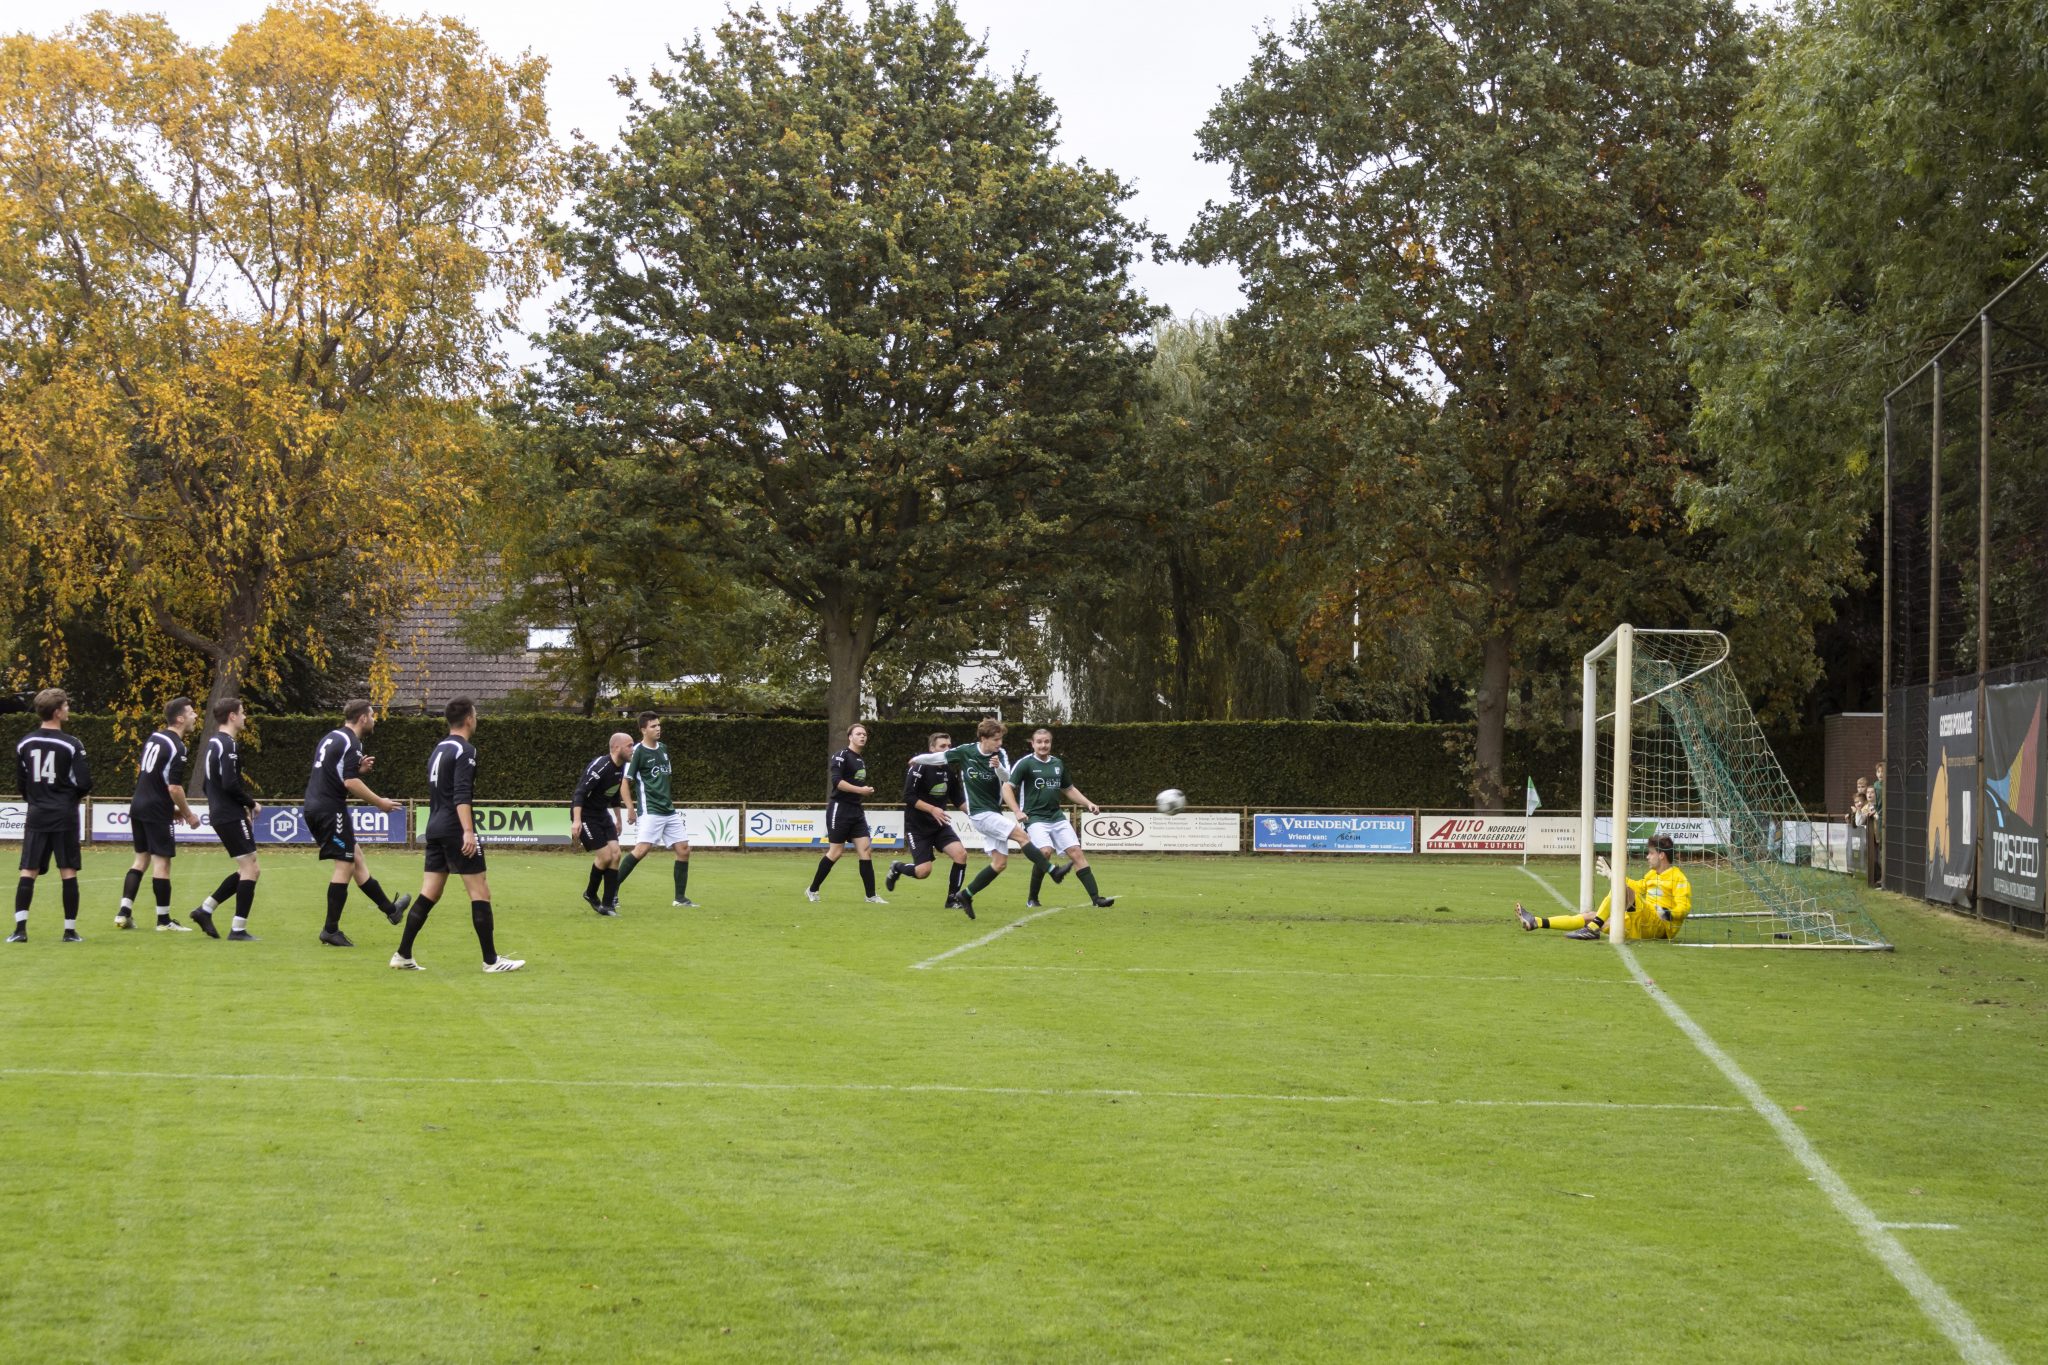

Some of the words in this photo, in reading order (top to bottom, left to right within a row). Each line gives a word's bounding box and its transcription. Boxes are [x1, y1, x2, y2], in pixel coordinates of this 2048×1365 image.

[31, 749, 56, 784] 14
[141, 742, 160, 773] 10
[430, 751, 442, 788] 4
[1430, 820, 1484, 839] AUTO
